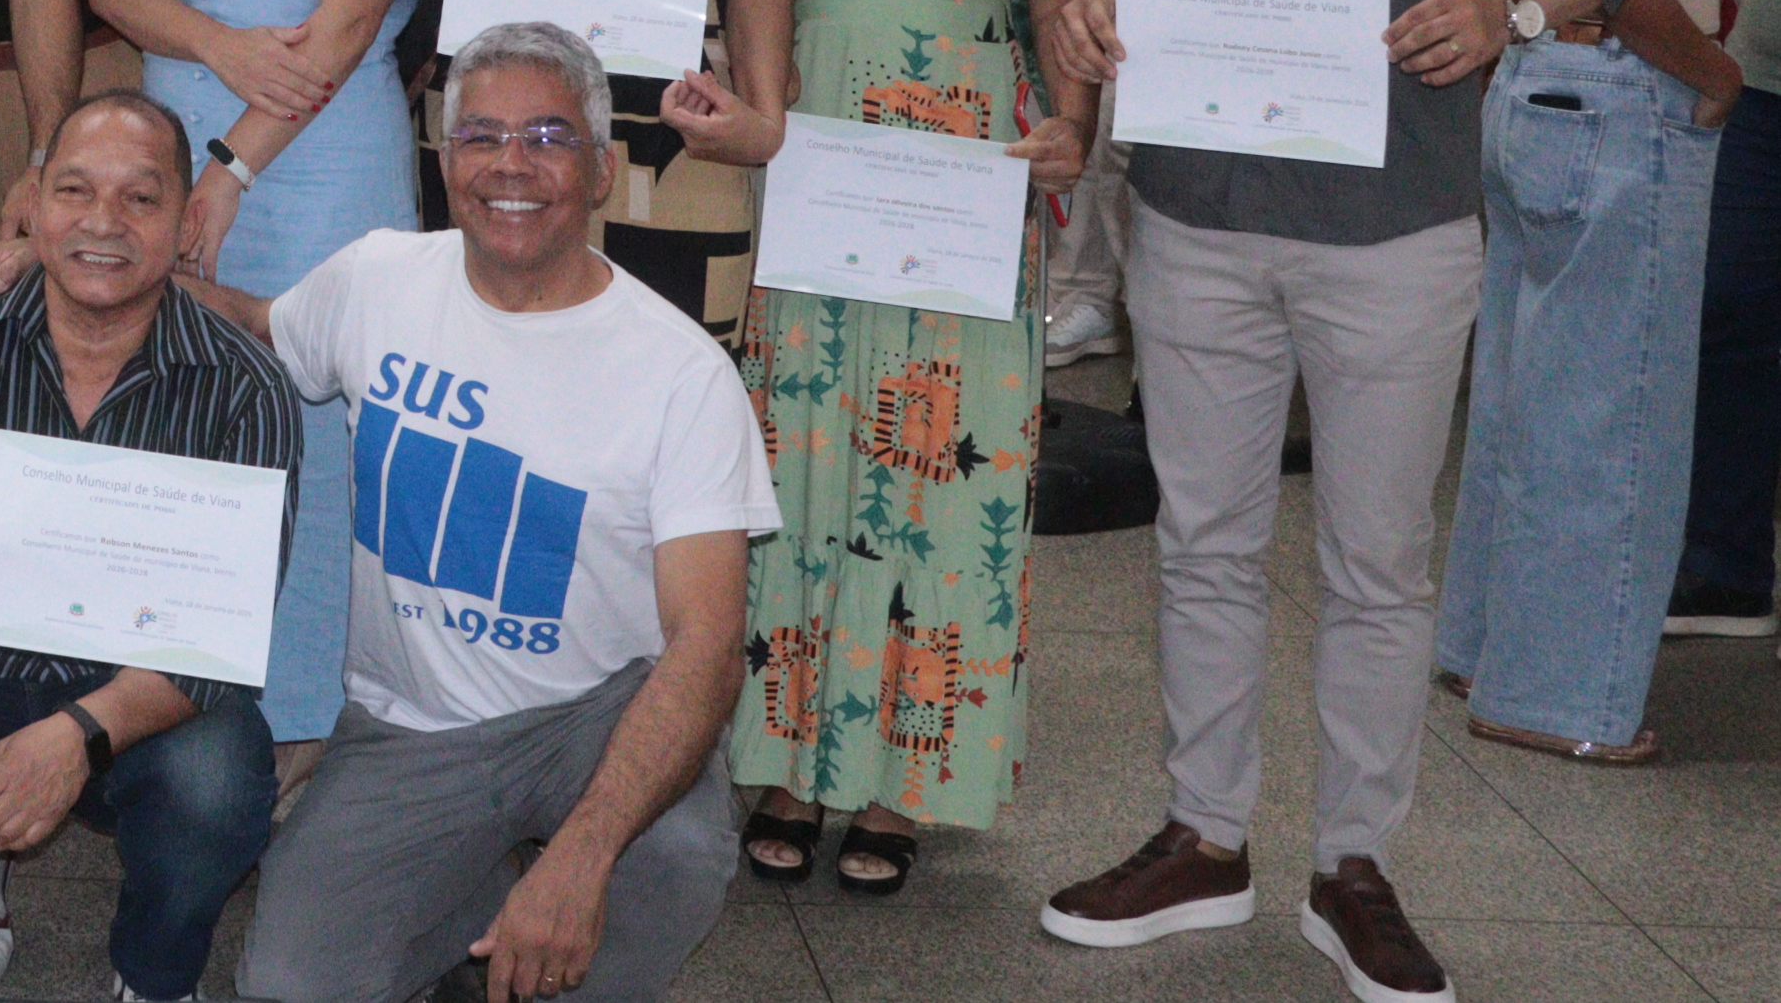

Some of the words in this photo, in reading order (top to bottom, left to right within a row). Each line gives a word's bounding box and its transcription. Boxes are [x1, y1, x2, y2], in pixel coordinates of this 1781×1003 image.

[1303, 0, 1317, 12] de
[1320, 2, 1350, 14] Viana
[805, 138, 850, 154] Conselho
[852, 145, 900, 163] Municipal
[902, 153, 915, 163] de
[950, 160, 963, 171] de
[965, 162, 993, 175] Viana
[368, 352, 489, 431] SUS
[21, 464, 73, 484] Conselho
[75, 472, 131, 495] Municipal
[133, 481, 149, 495] de
[152, 483, 187, 502] Saúde
[190, 489, 206, 504] de
[208, 493, 241, 510] Viana
[89, 494, 139, 509] CERTIFICADO
[141, 502, 151, 511] DE
[153, 504, 177, 514] POSSE
[100, 536, 131, 548] Robson
[132, 541, 169, 554] Menezes
[170, 547, 199, 558] Santos
